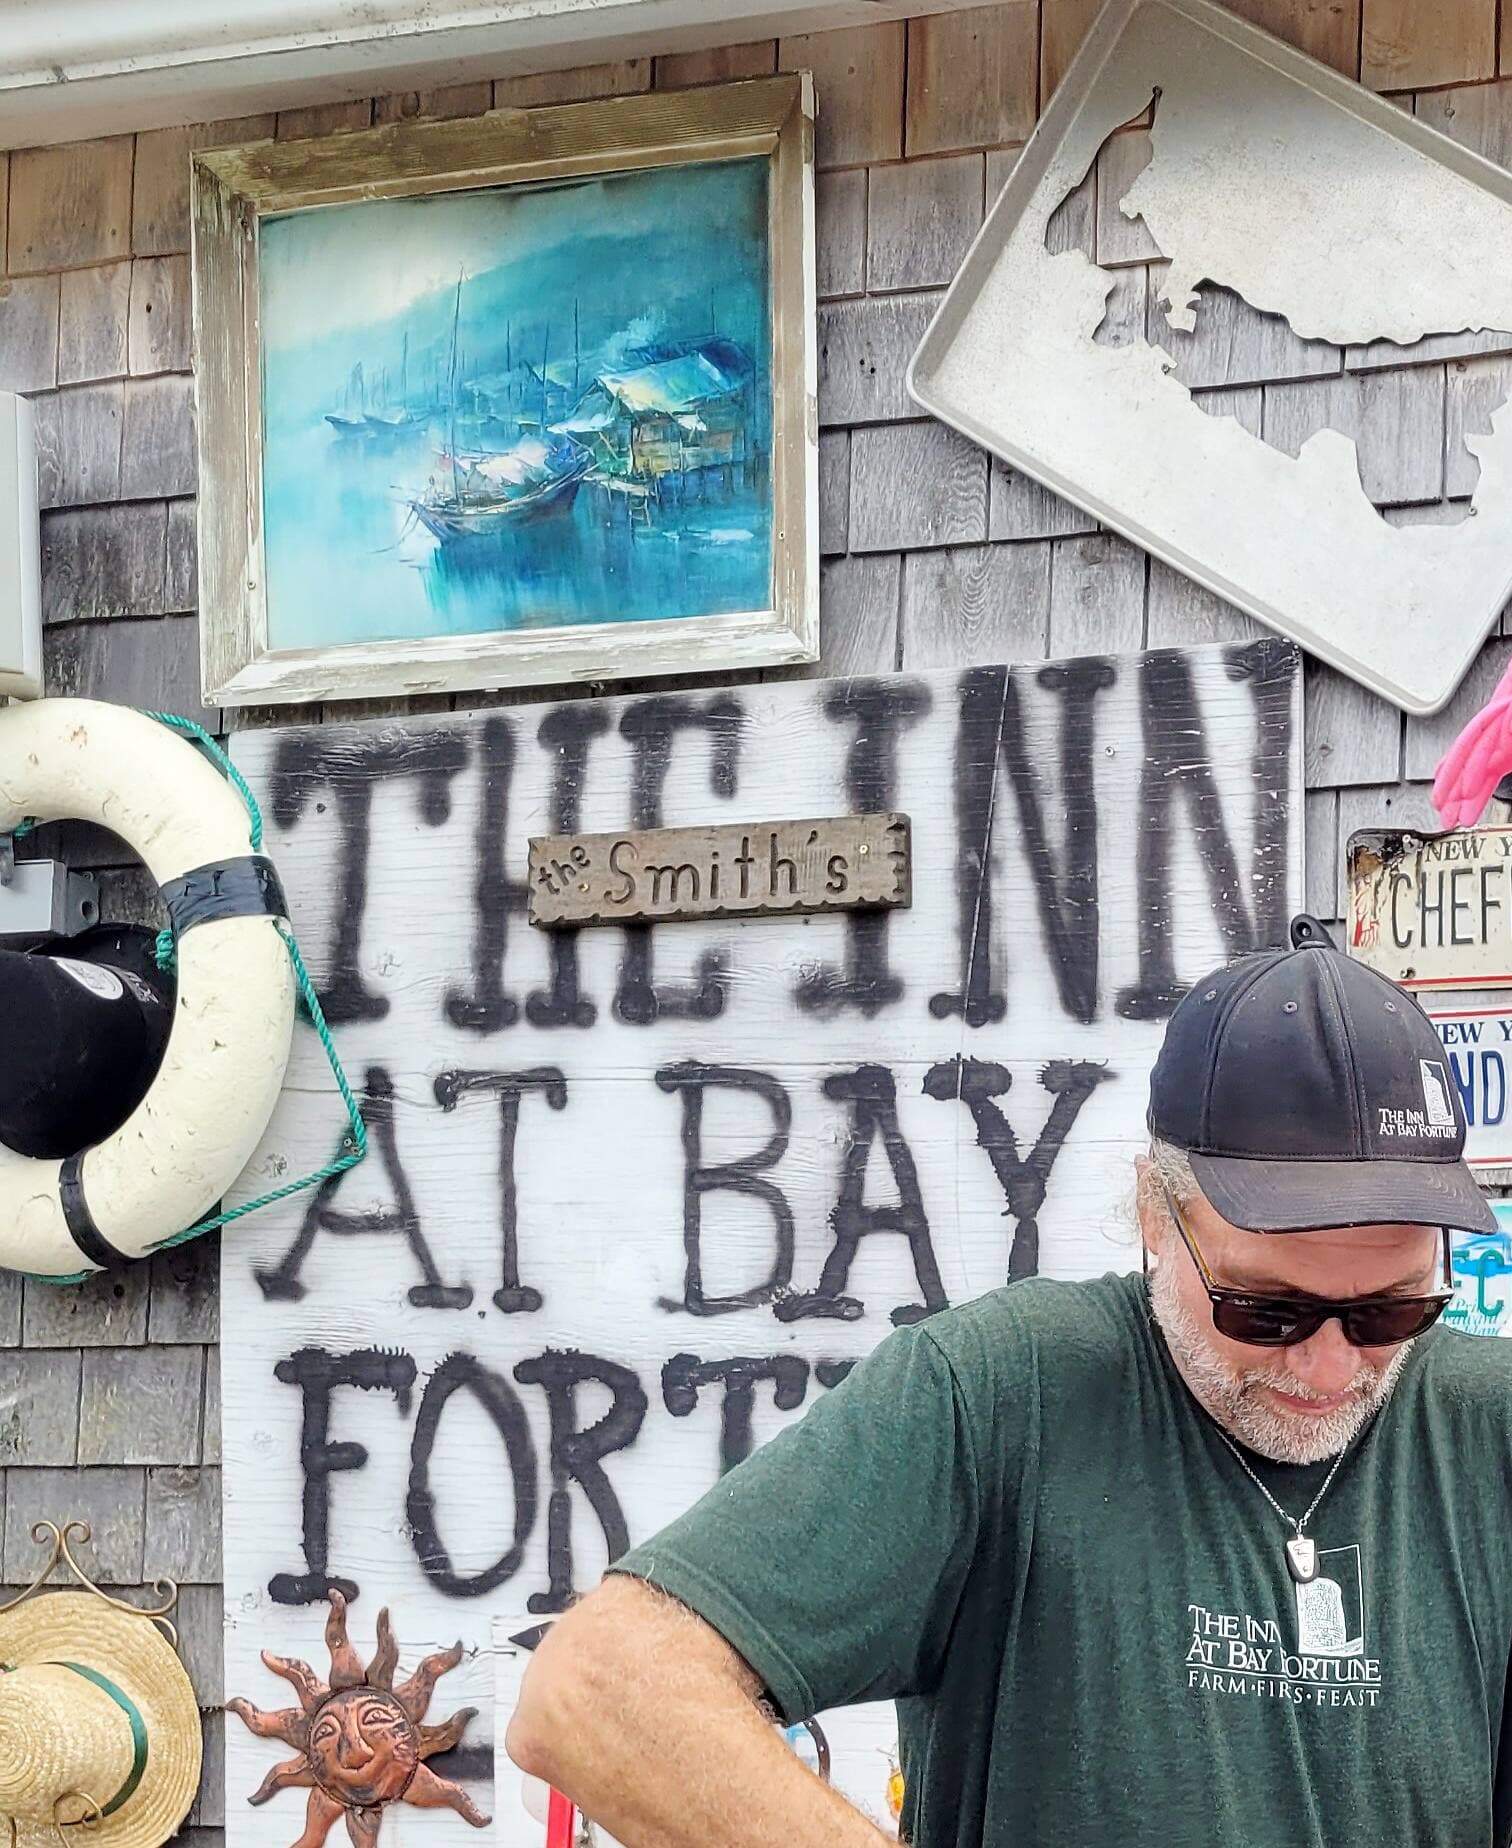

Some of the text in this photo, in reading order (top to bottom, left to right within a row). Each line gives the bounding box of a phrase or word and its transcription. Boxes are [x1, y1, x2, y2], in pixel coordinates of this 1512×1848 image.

[268, 638, 1302, 1029] THE INN
[1426, 838, 1486, 862] NEW
[537, 830, 850, 912] the Smith's
[1378, 1108, 1425, 1125] THE INN
[1379, 1122, 1458, 1139] AT BAY FORTUNE
[253, 1053, 1117, 1325] AT BAY
[1188, 1604, 1282, 1645] THE INN
[1186, 1633, 1220, 1664] AT
[1228, 1640, 1273, 1673] BAY
[1188, 1670, 1246, 1696] FARM
[1316, 1688, 1380, 1707] FEAST
